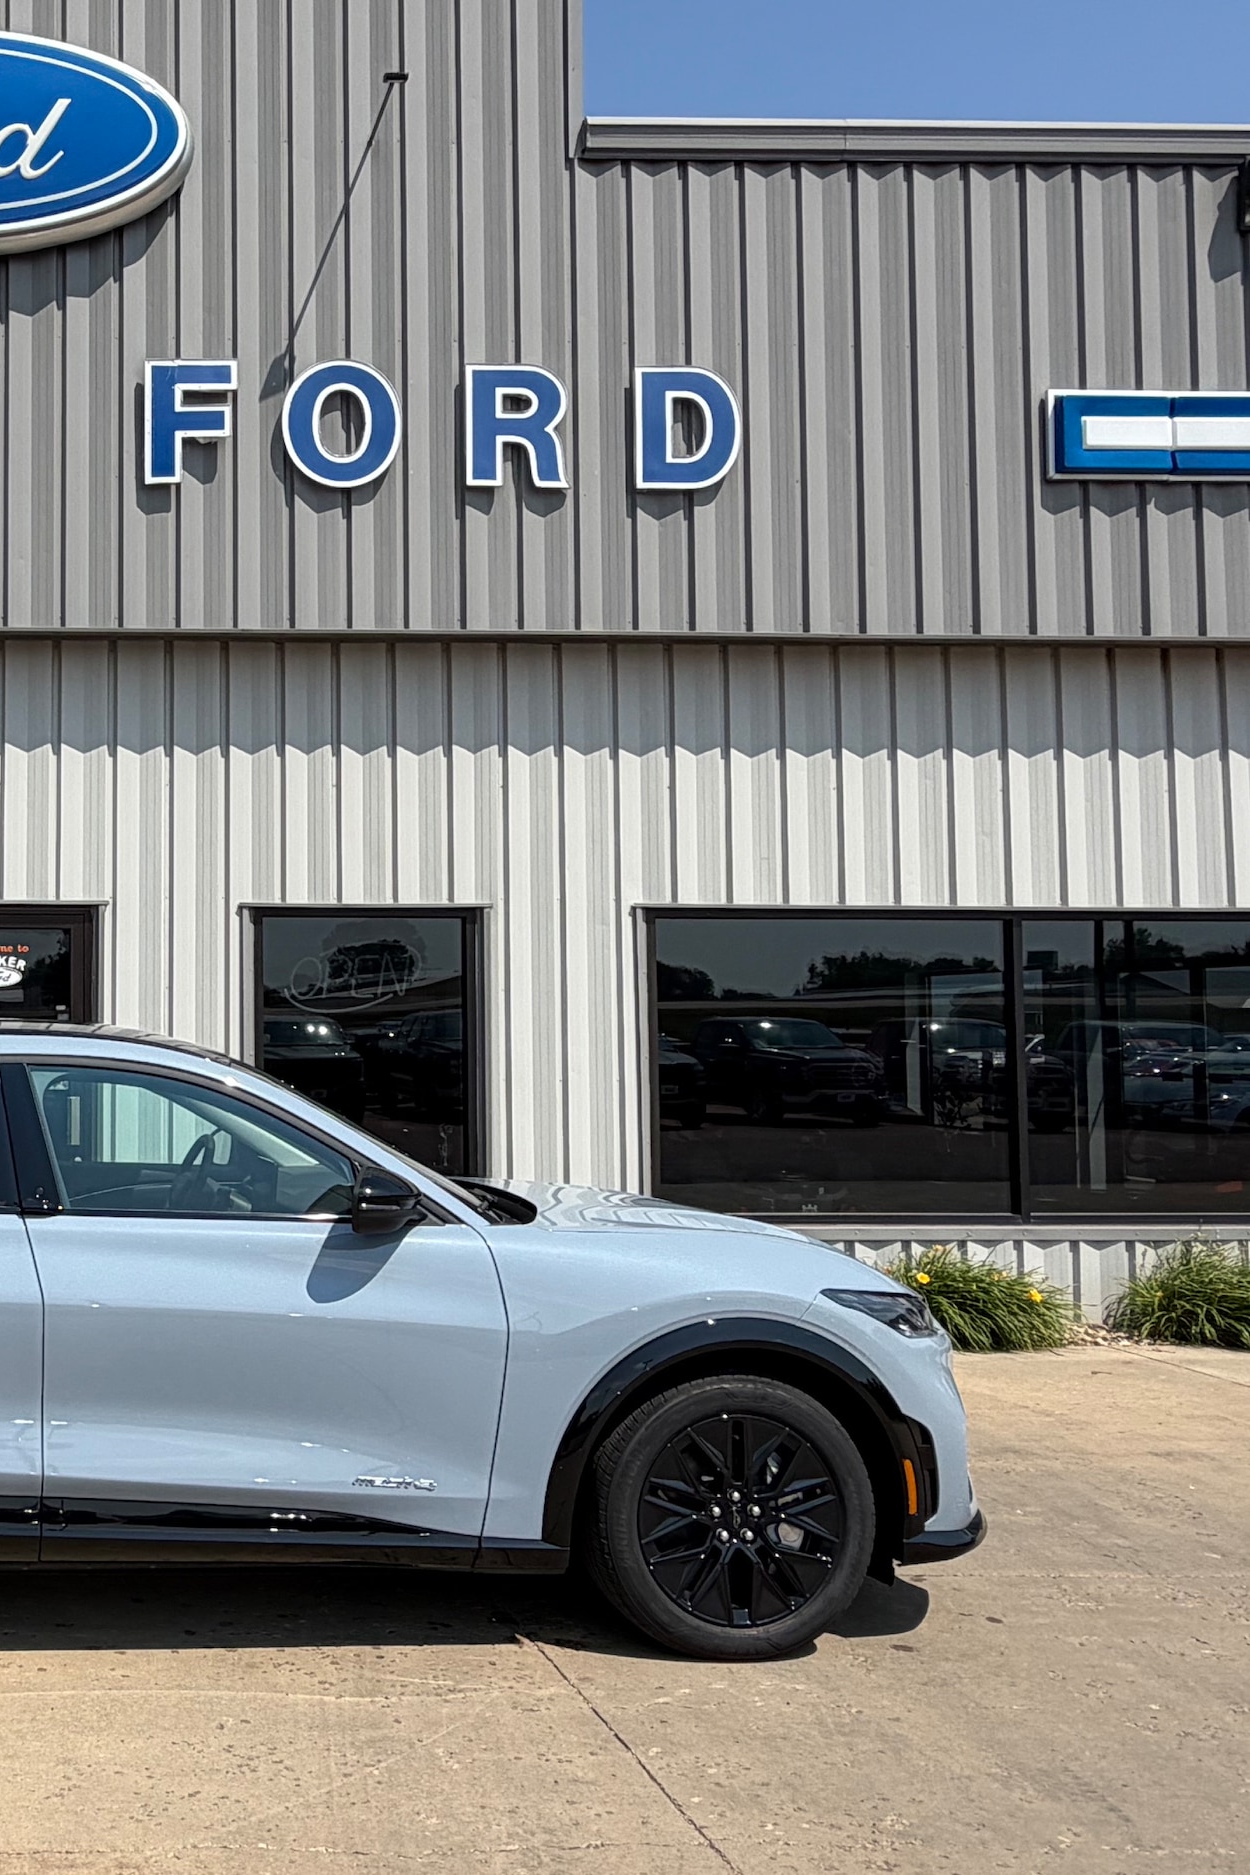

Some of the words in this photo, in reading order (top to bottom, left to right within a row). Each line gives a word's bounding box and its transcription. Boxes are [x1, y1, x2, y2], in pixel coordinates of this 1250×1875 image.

[144, 358, 743, 490] FORD
[17, 943, 30, 953] to
[291, 953, 411, 1000] OPEN
